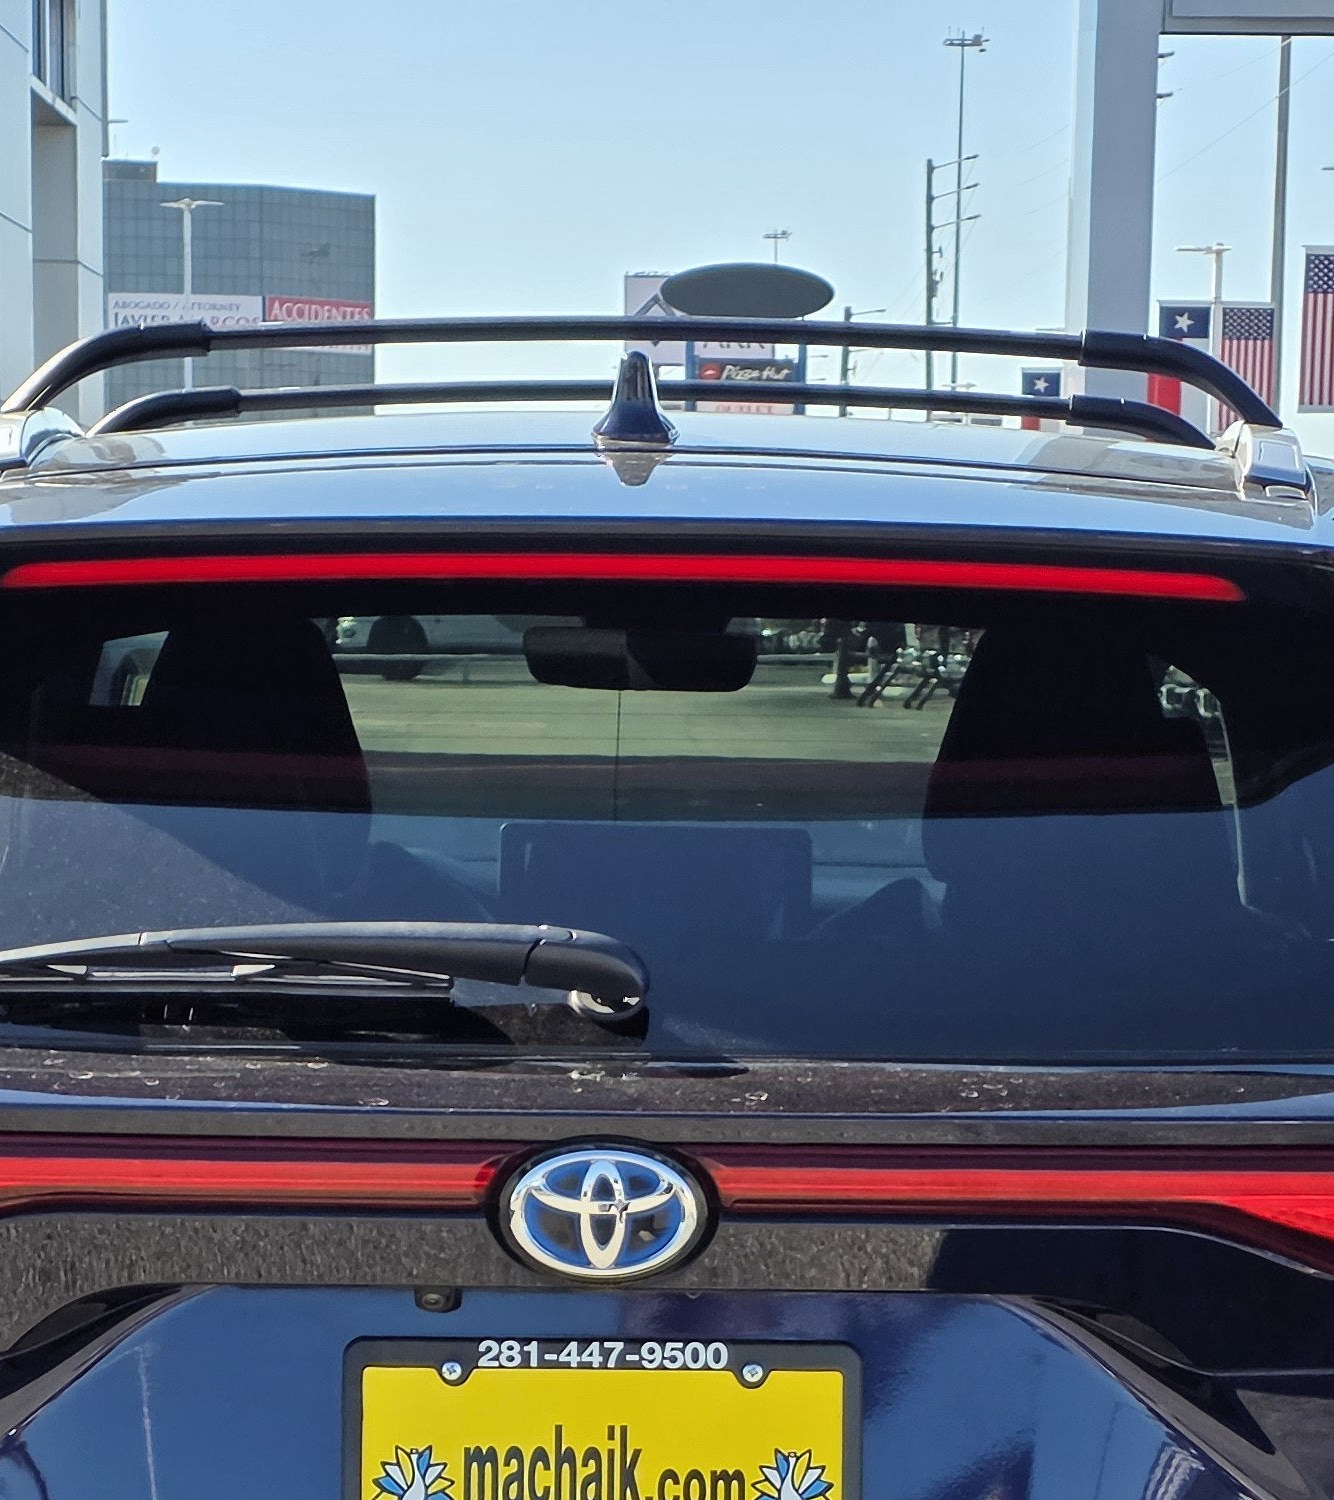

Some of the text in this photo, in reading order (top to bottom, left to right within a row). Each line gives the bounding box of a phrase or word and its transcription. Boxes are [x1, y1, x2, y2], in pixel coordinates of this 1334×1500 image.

[270, 299, 372, 321] ACCIDENTES
[720, 364, 761, 381] Pizza
[477, 1340, 729, 1369] 281-447-9500
